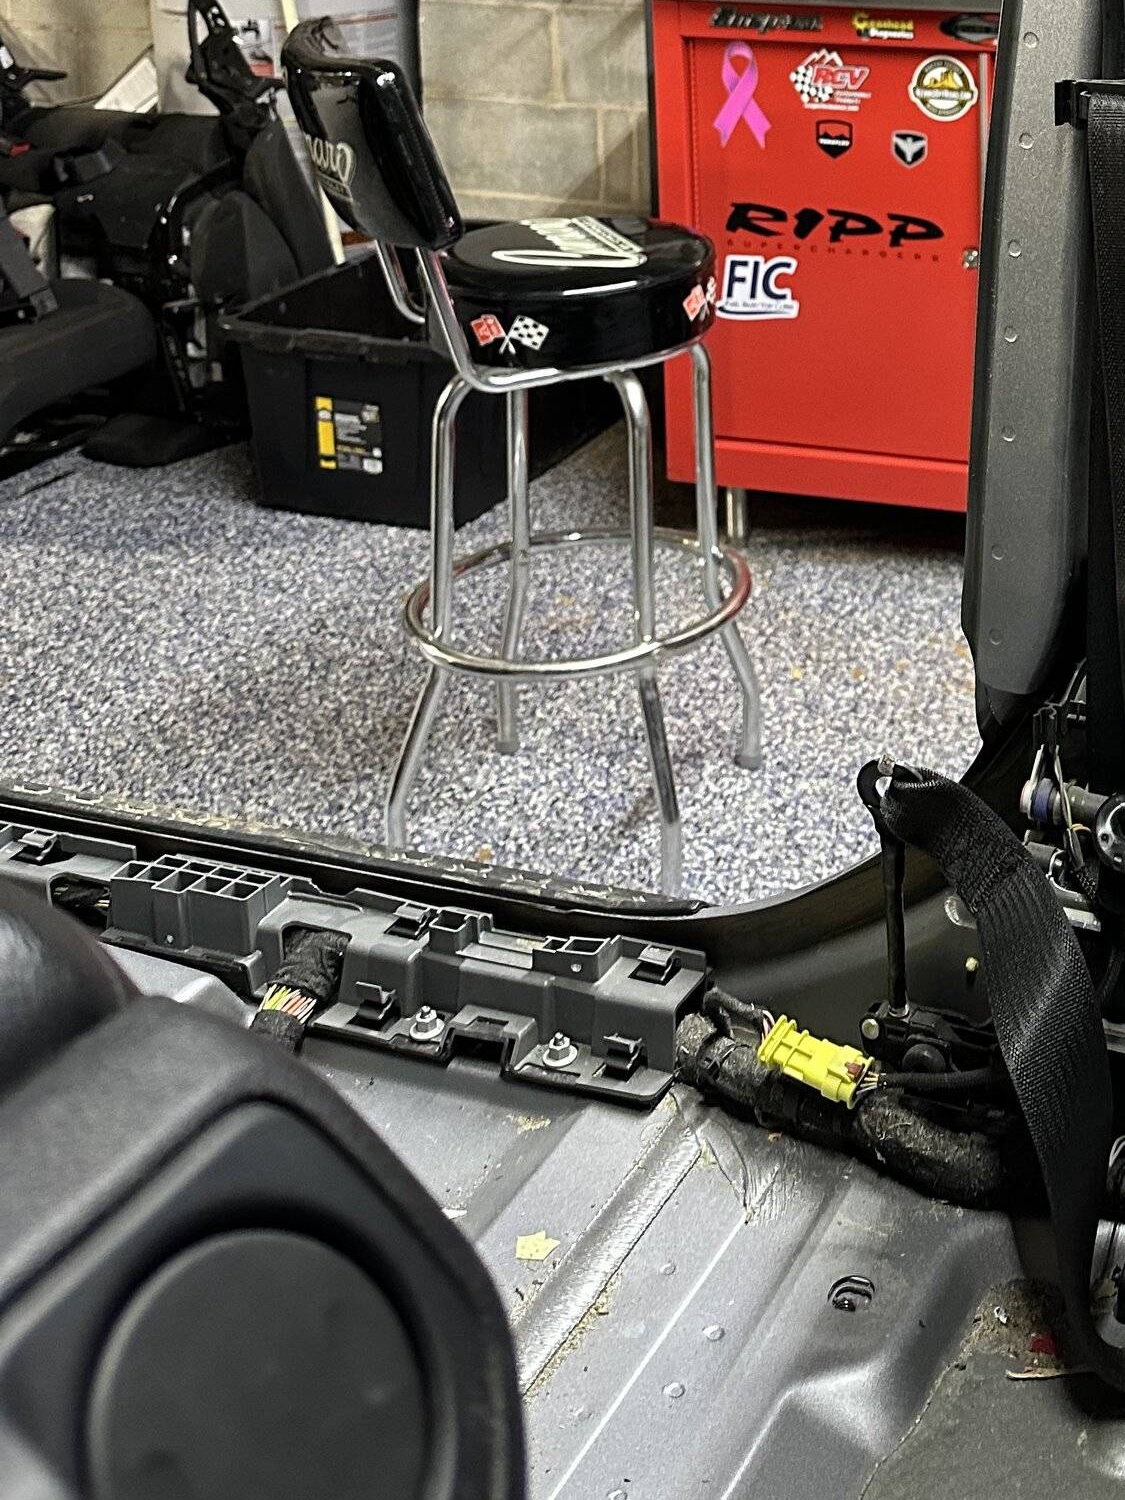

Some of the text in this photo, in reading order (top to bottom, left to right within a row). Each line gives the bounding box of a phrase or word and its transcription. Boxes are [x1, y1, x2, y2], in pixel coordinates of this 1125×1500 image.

[812, 65, 870, 90] RCV
[725, 202, 944, 248] RIPP
[726, 259, 793, 301] FIC
